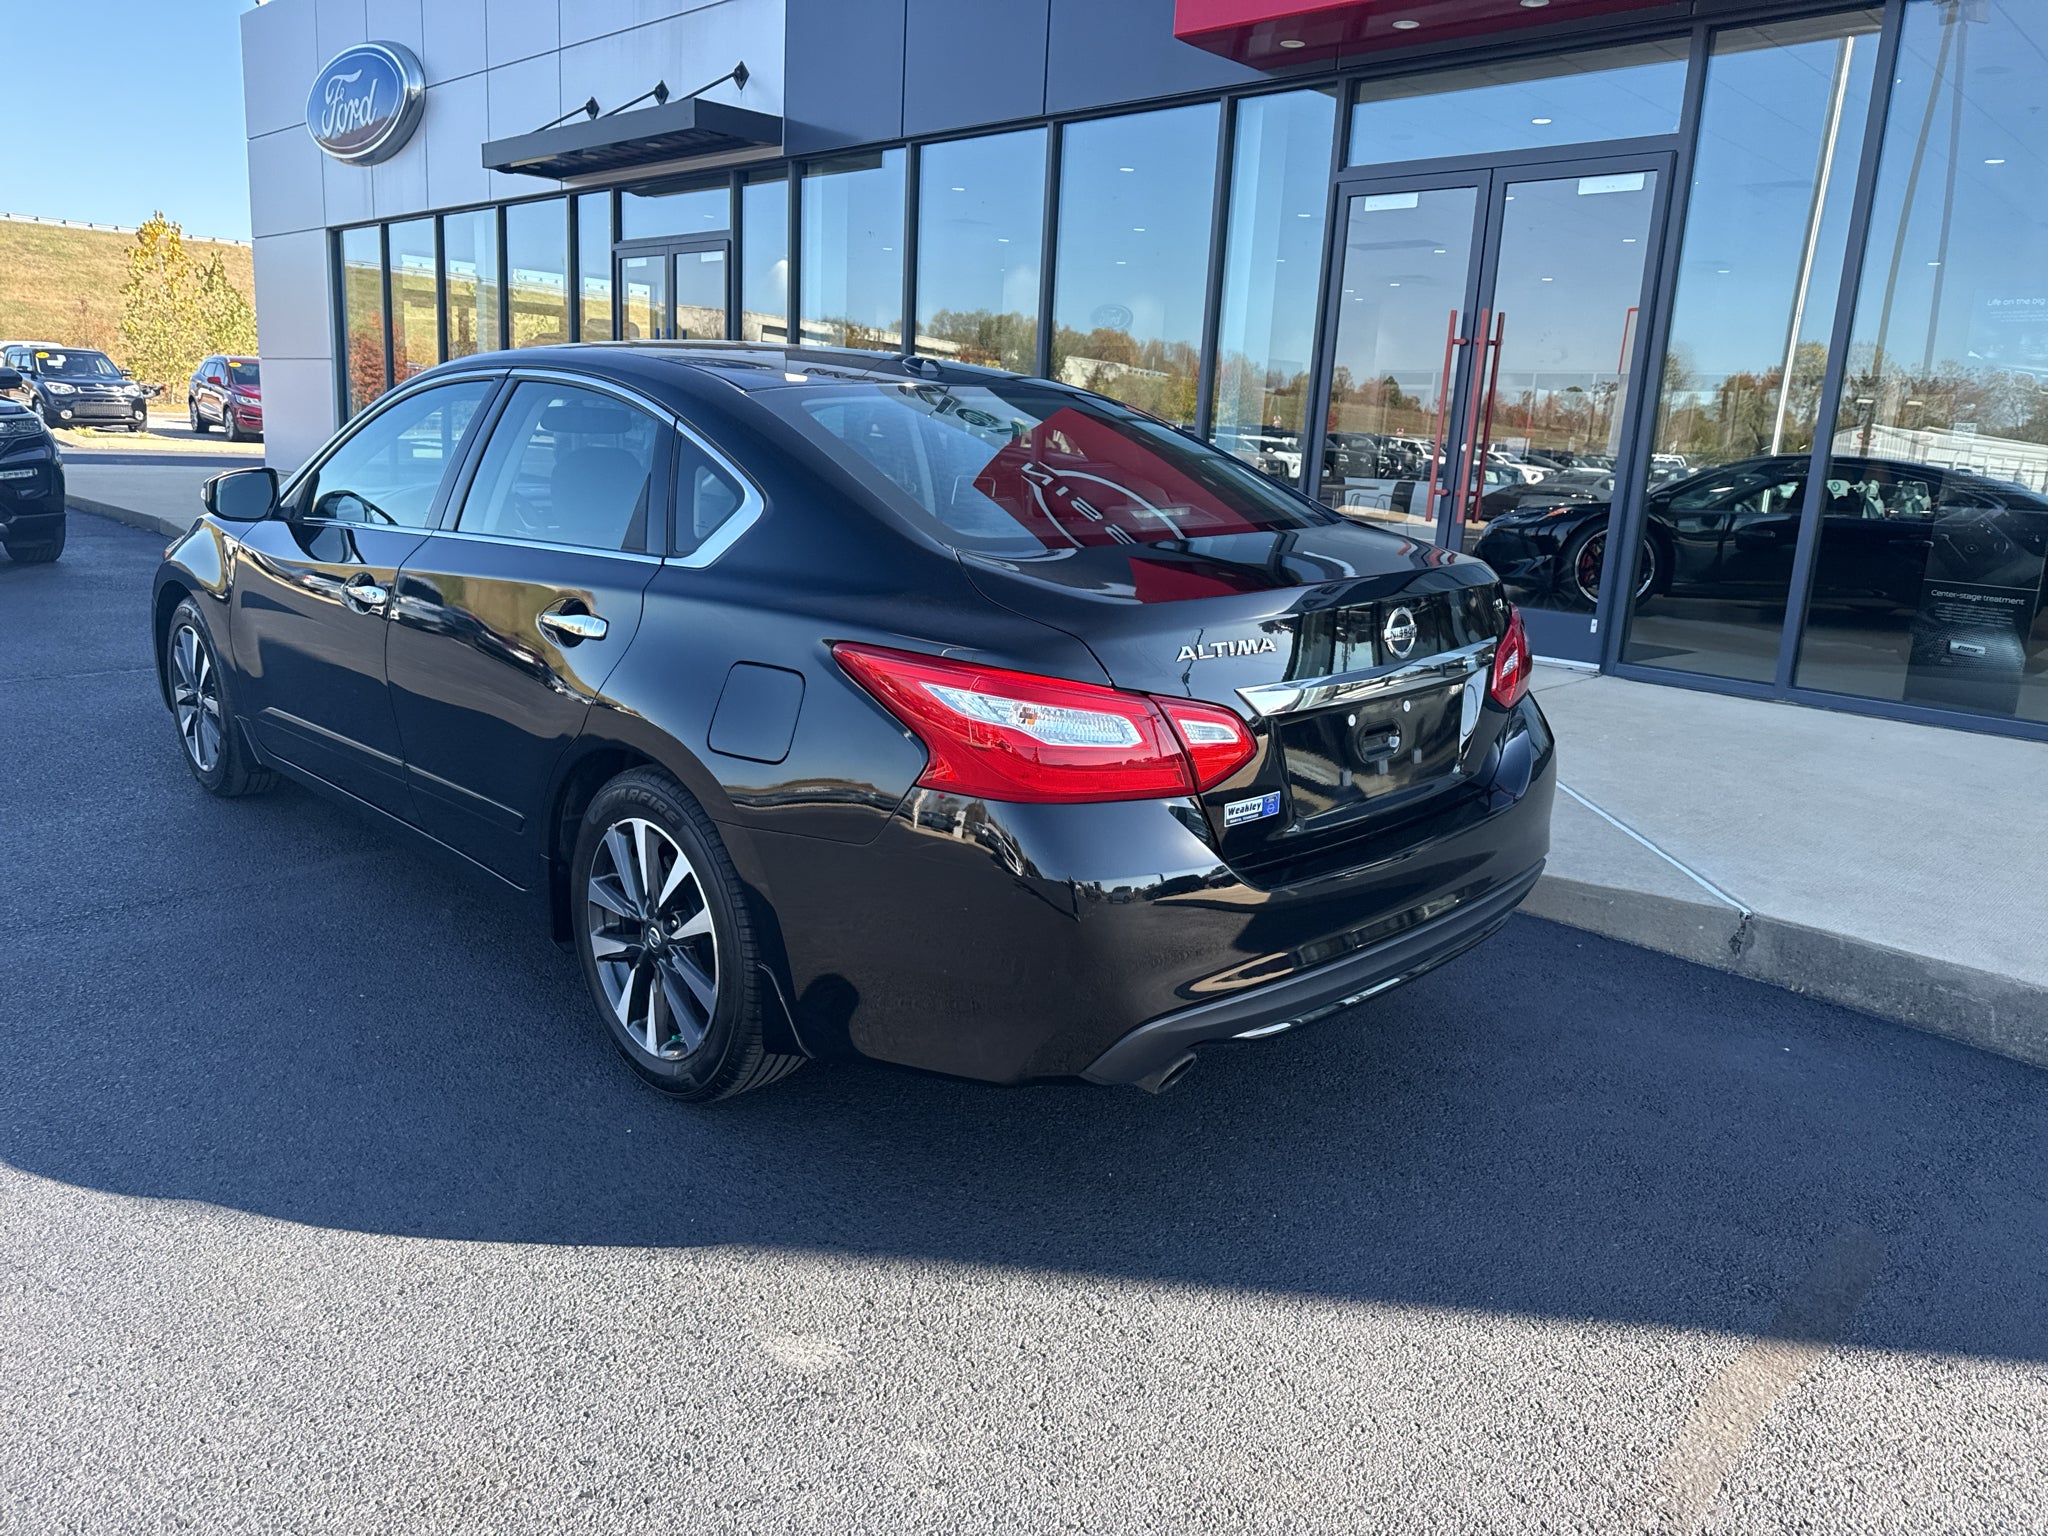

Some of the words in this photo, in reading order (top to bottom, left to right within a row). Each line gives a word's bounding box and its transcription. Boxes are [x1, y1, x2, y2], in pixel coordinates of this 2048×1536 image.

[322, 69, 378, 138] Ford
[1987, 298, 2001, 306] Life
[2003, 298, 2014, 306] on
[2032, 297, 2046, 306] big
[1931, 589, 1982, 601] Center-stage
[1983, 595, 2025, 606] treatment
[1176, 637, 1277, 662] ALTIMA
